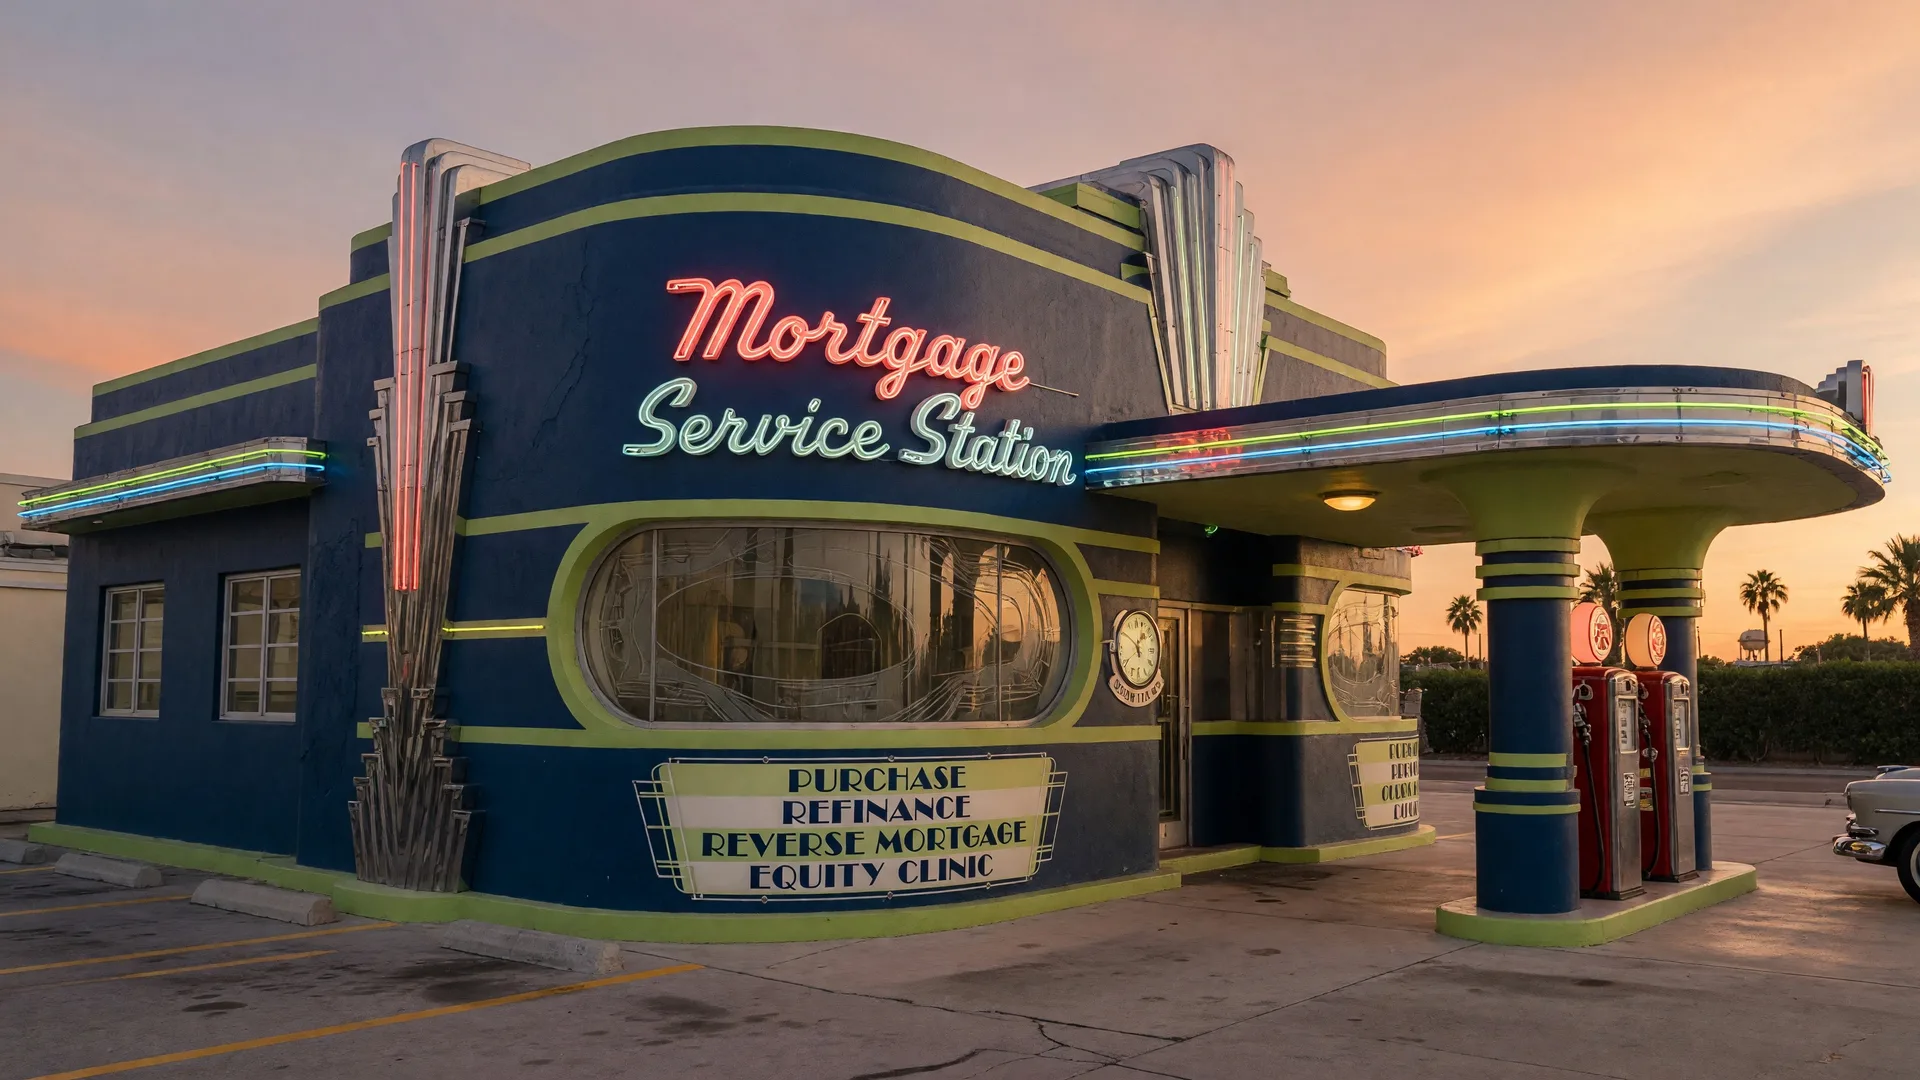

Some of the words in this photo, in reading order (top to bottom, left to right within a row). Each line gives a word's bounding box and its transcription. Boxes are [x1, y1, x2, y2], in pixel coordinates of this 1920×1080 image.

[666, 278, 1030, 410] Mortgage
[622, 377, 890, 460] Service
[898, 392, 1077, 487] Station
[788, 765, 967, 793] PURCHASE
[782, 795, 971, 824] REFINANCE
[701, 832, 867, 857] REVERSE
[875, 821, 1027, 853] MORTGAGE
[749, 862, 889, 890] EQUITY
[897, 854, 994, 884] CLINIC
